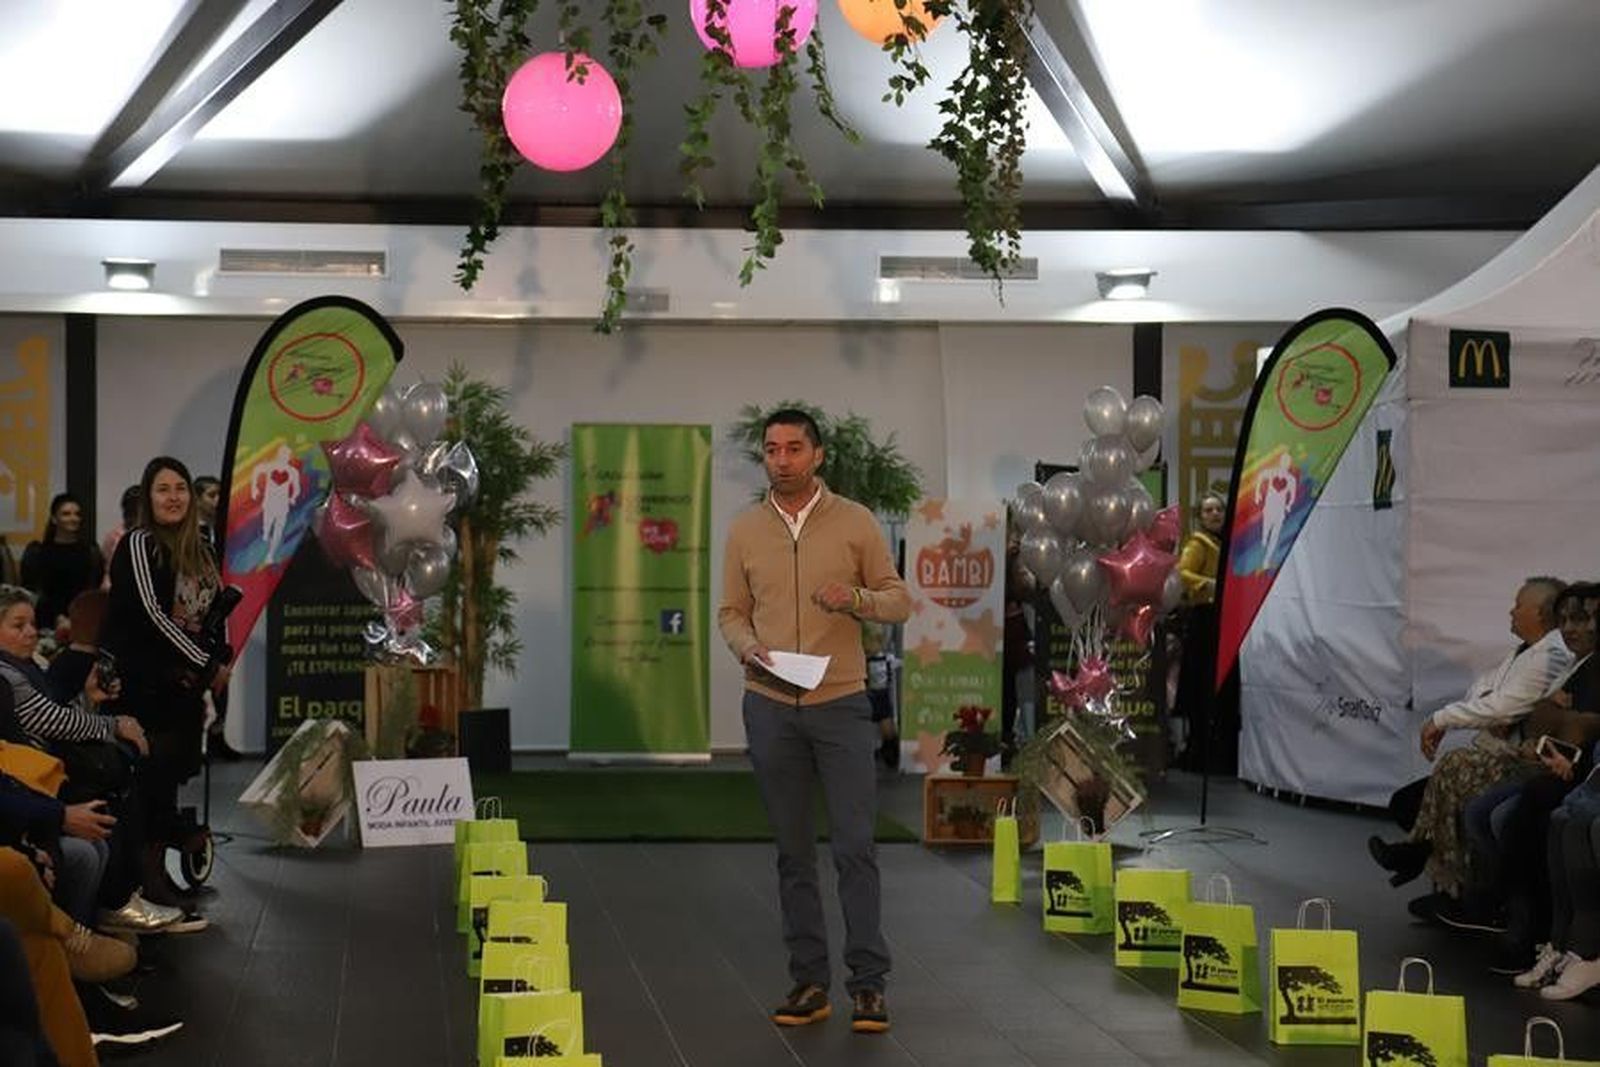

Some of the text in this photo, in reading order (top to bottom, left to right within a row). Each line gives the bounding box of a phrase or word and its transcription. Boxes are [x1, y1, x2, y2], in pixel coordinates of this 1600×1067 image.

[921, 556, 990, 587] BAMBI
[280, 696, 301, 719] El
[366, 776, 464, 818] Paula
